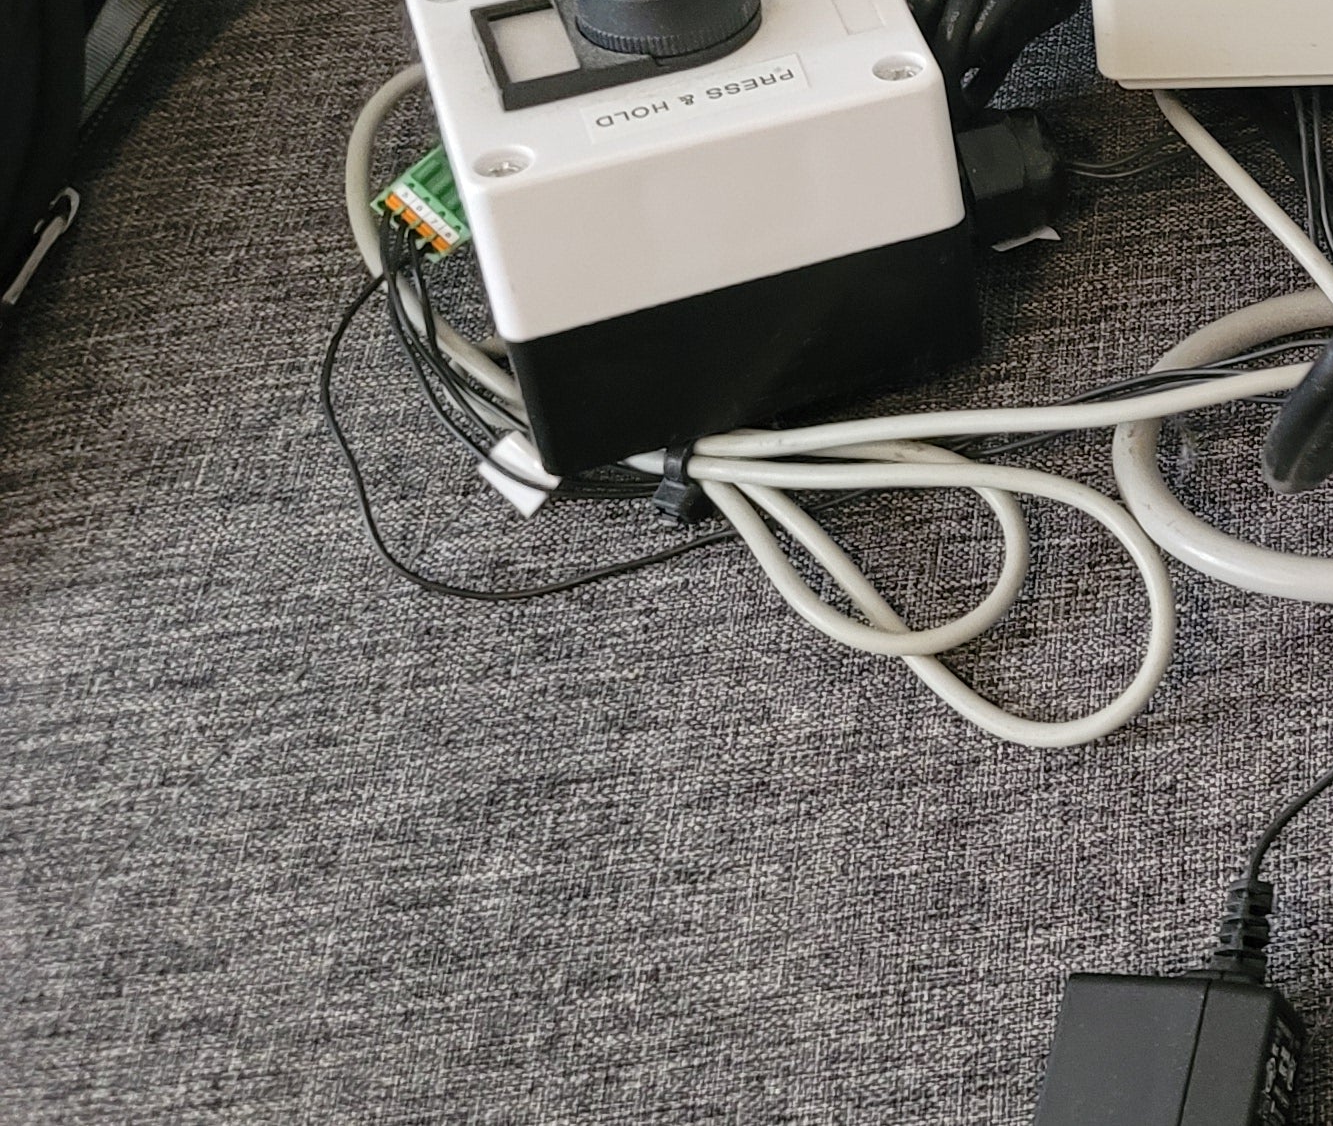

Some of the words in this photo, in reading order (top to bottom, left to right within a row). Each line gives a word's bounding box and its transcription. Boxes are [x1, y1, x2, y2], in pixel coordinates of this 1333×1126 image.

[705, 68, 795, 100] PRESS
[677, 93, 695, 106] &
[595, 100, 670, 128] HOLD
